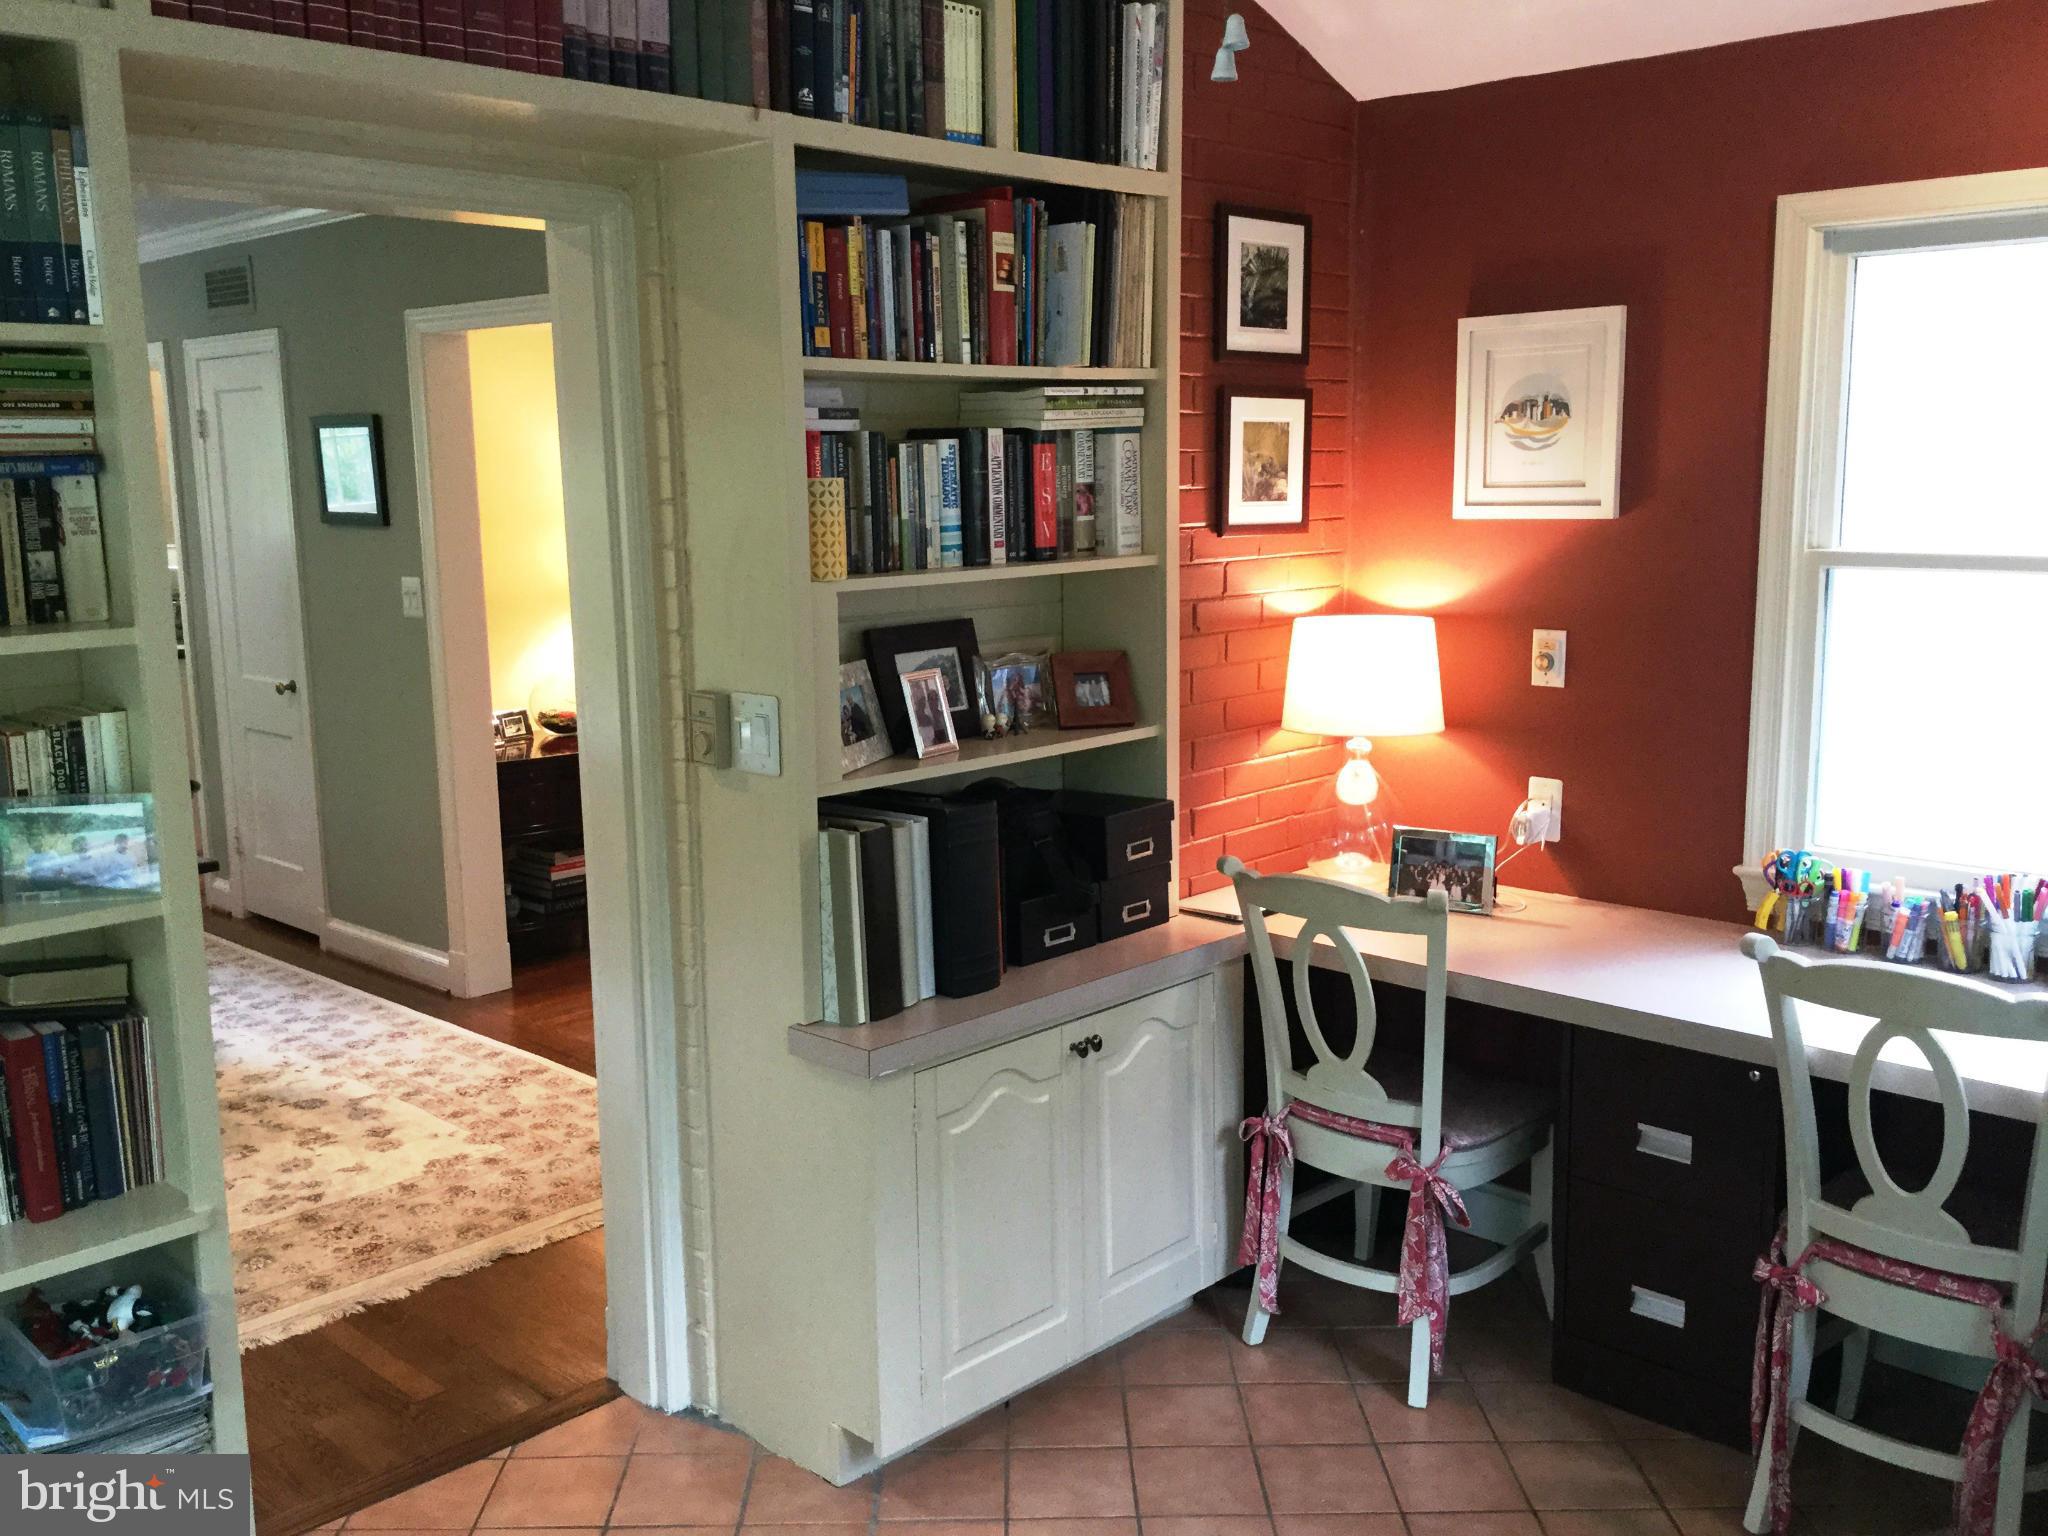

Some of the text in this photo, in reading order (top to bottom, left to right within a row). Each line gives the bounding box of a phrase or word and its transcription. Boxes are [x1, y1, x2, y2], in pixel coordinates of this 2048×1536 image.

[1, 150, 17, 211] ROMANS
[31, 151, 48, 212] ROMANS
[57, 148, 78, 225] EPHESIANS
[815, 274, 826, 324] FRANCE
[941, 456, 951, 509] THEOLOGY
[948, 443, 959, 509] SYSTEMATIC
[992, 455, 1003, 495] APPLICATION
[1077, 432, 1086, 479] COMMENTARY
[1085, 432, 1093, 479] NEW BIBLE
[1122, 439, 1134, 516] COMMENTARY
[993, 496, 1004, 540] COMMENTARY
[52, 730, 66, 789] BLACK DOG
